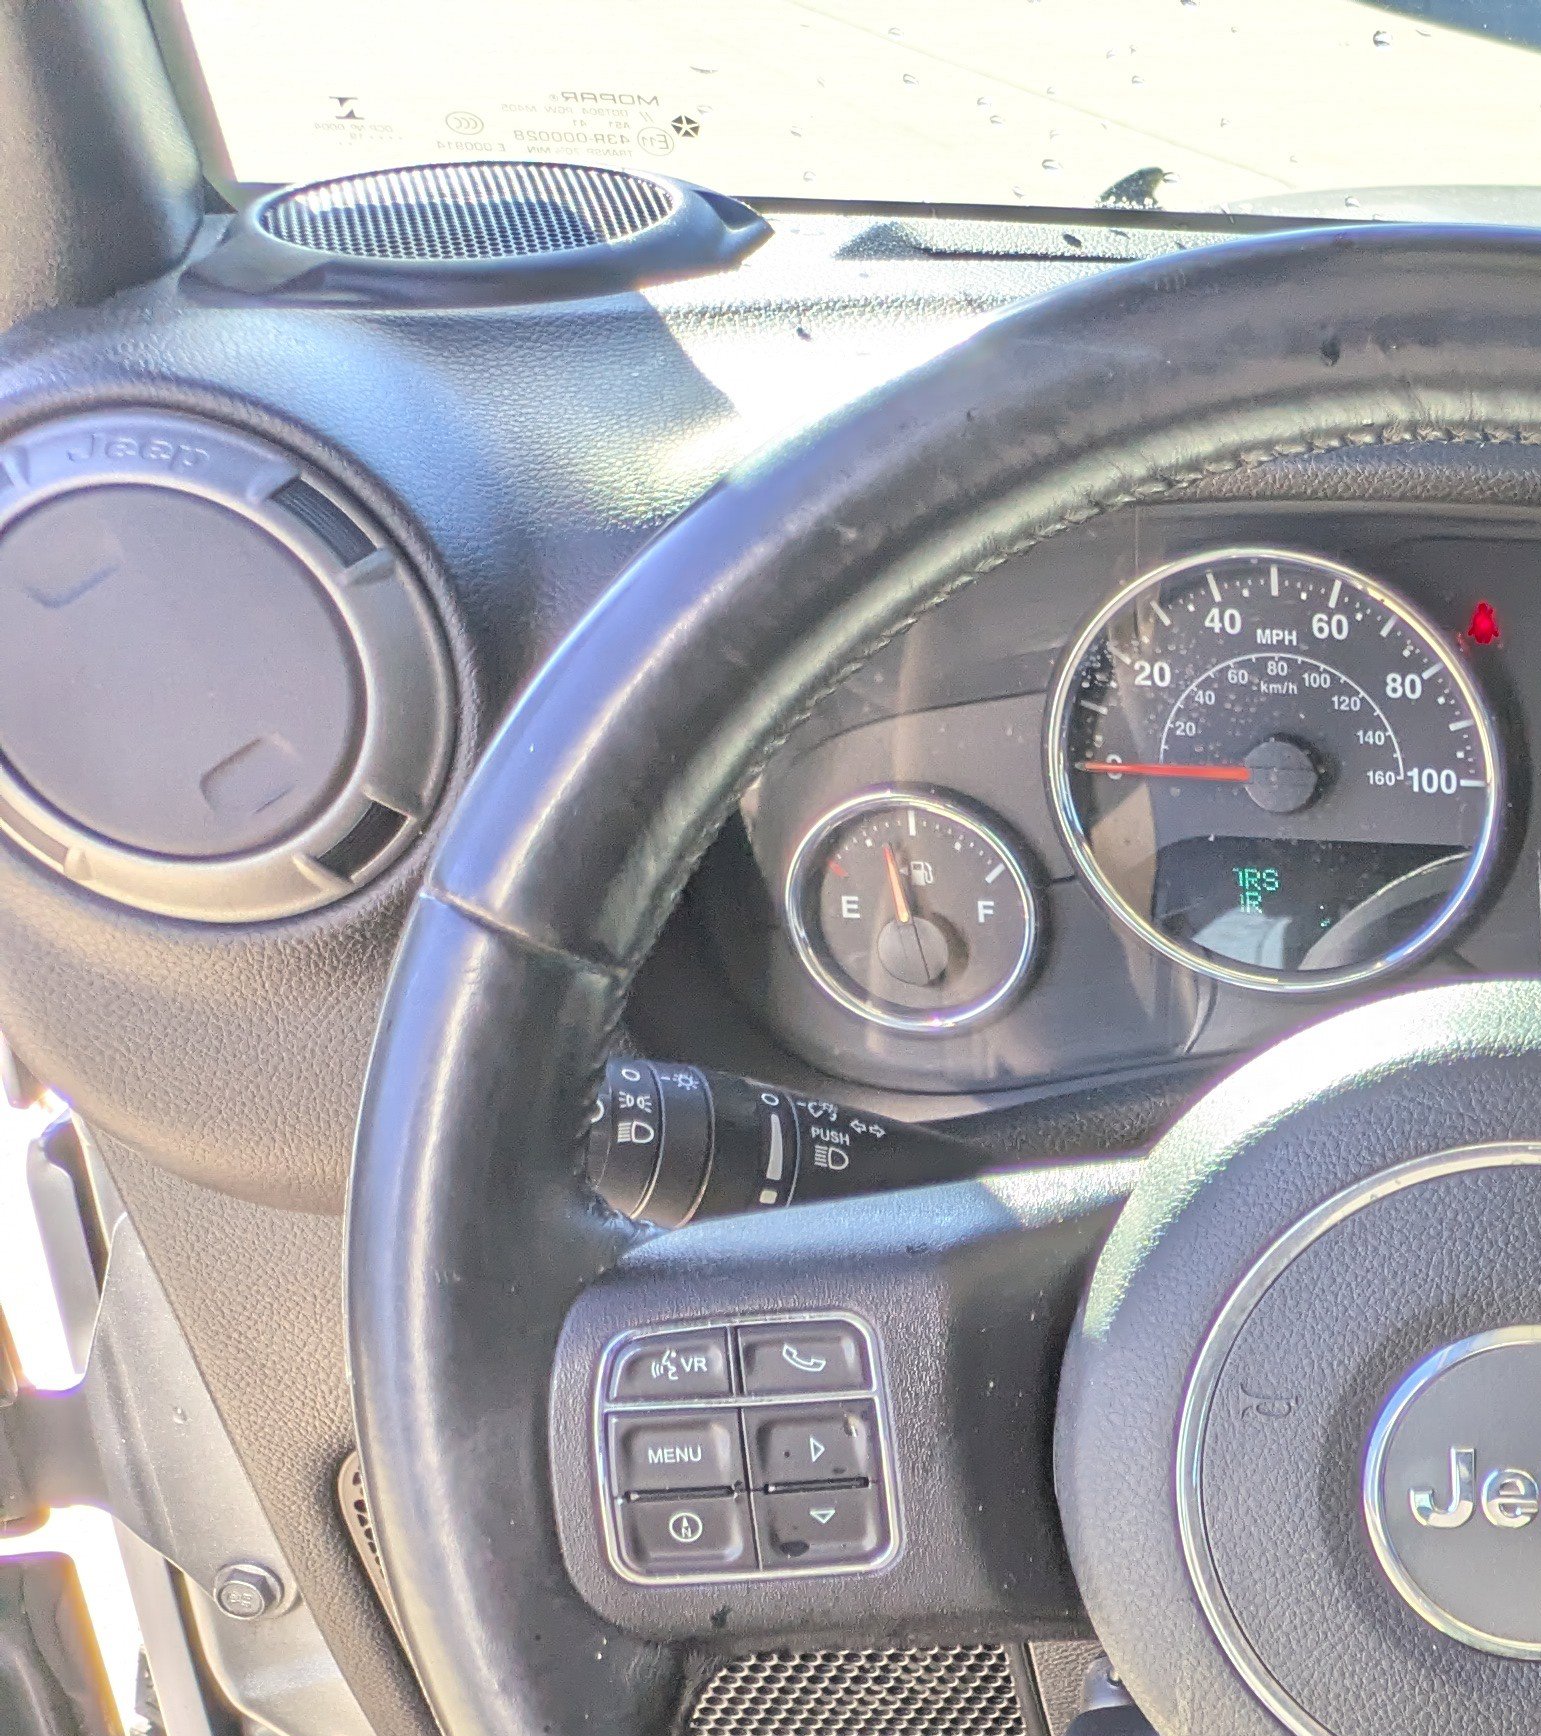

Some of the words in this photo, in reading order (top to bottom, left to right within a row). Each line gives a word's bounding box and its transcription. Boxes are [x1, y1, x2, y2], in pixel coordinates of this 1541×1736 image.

[67, 433, 210, 474] Jeep
[1205, 608, 1241, 635] 40
[1312, 614, 1349, 640] 60
[1257, 630, 1298, 646] MPH
[1134, 661, 1170, 687] 20
[1228, 669, 1249, 685] 60
[1267, 661, 1288, 676] 80
[1260, 679, 1298, 695] km/h
[1302, 672, 1331, 689] 100
[1386, 673, 1422, 700] 80
[1195, 690, 1216, 706] 40
[1332, 696, 1361, 711] 120
[1175, 721, 1196, 737] 20
[1357, 731, 1386, 746] 140
[1366, 770, 1396, 786] 160
[1407, 768, 1457, 795] 100
[841, 896, 861, 919] E
[977, 900, 995, 923] F
[810, 1126, 851, 1146] PUSH
[681, 1357, 708, 1373] VR
[648, 1445, 702, 1464] MENU
